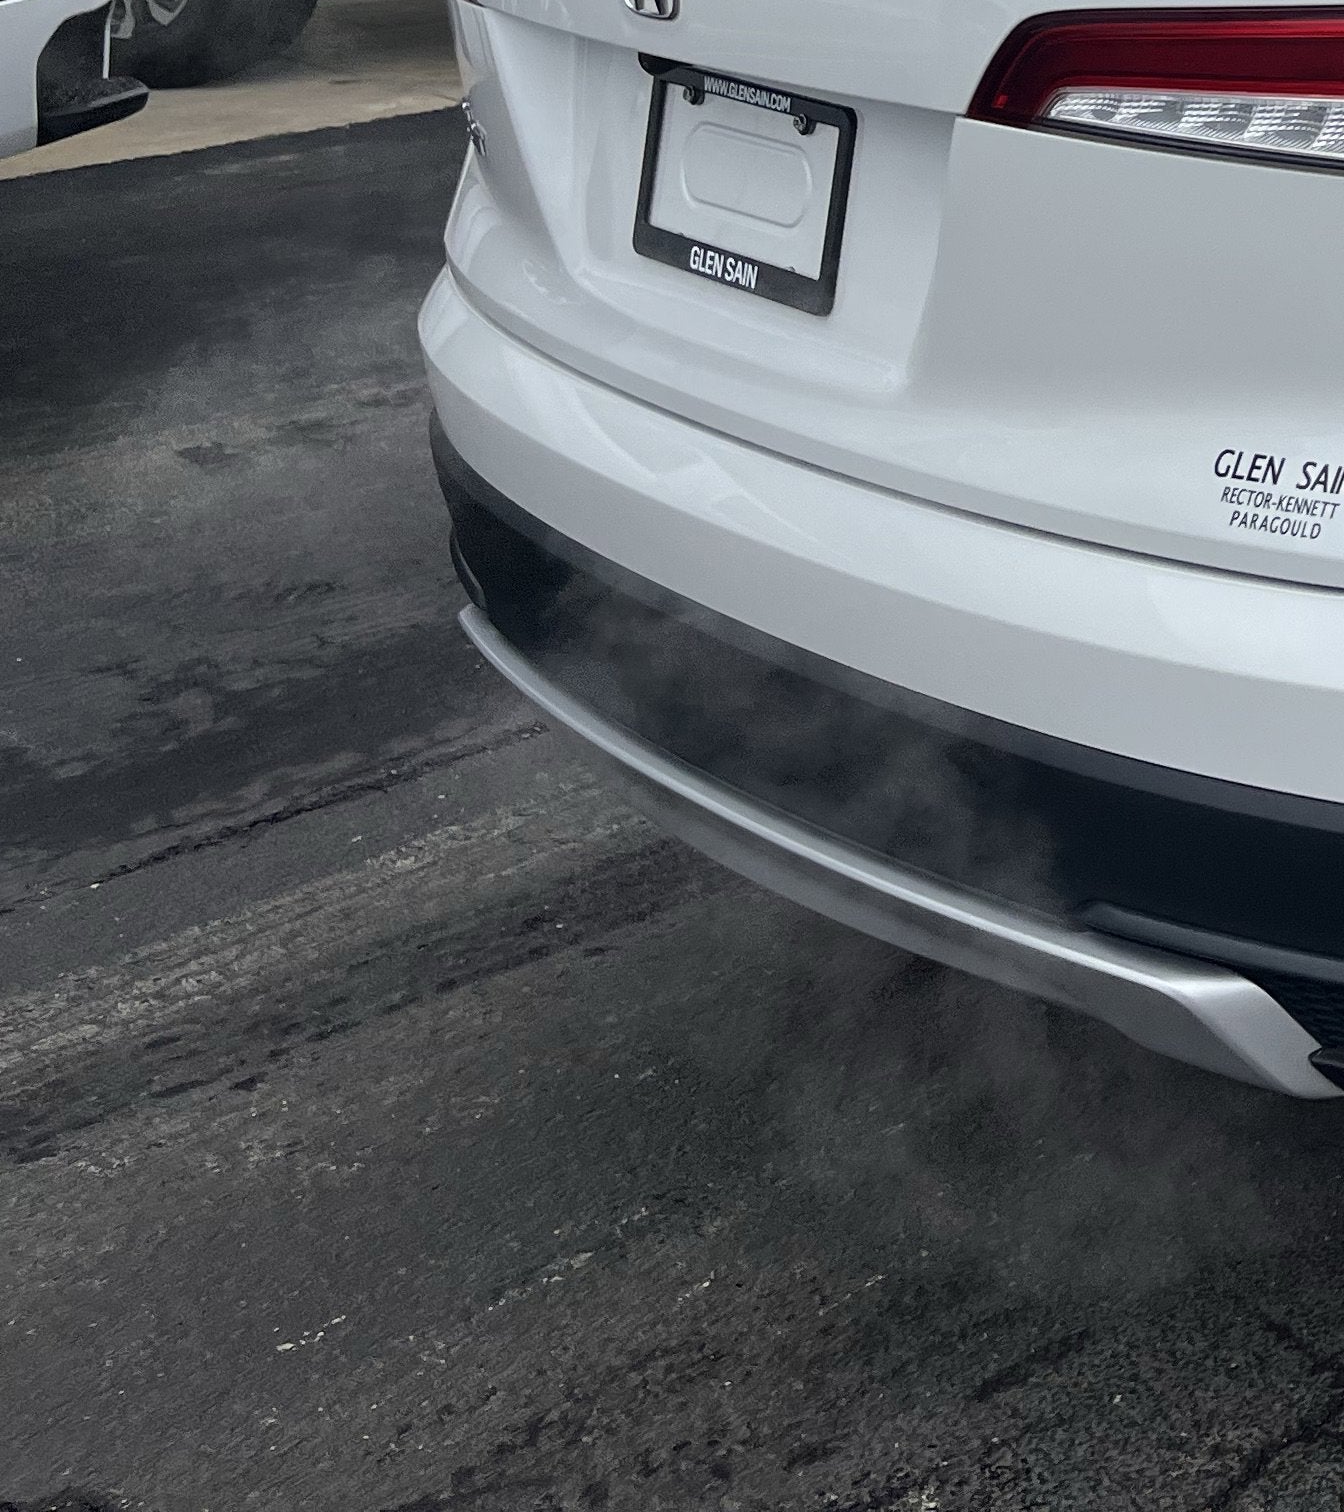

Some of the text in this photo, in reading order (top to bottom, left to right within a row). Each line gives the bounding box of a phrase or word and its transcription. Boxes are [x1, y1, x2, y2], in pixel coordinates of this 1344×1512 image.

[704, 76, 791, 112] WWW.GLENSAIN.COM
[689, 246, 759, 289] GLEN SAIN
[1214, 449, 1286, 485] GLEN
[1220, 486, 1341, 519] RECTOR-KENNETT
[1229, 510, 1322, 539] PARAGOULD
